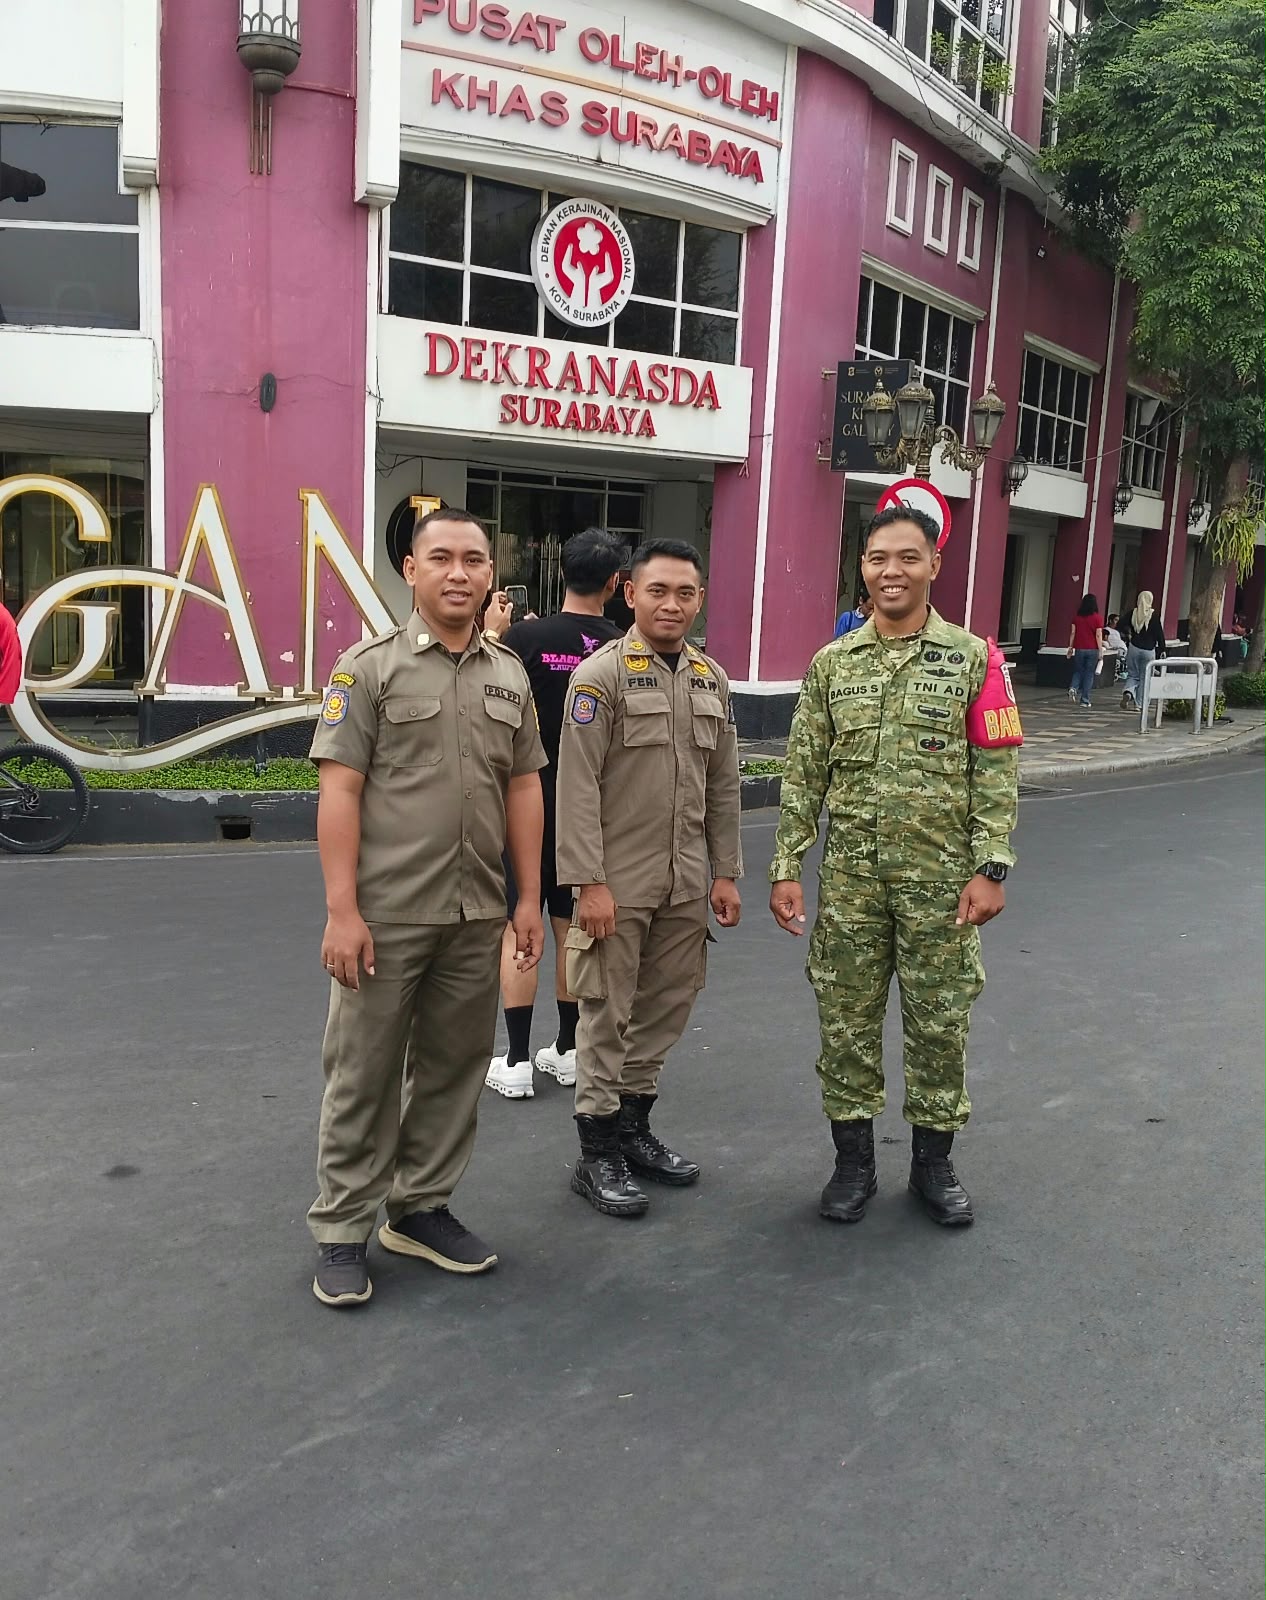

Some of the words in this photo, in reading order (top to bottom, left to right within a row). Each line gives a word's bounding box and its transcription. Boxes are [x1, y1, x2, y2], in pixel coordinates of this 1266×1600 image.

[413, 0, 567, 52] PUSAT
[578, 27, 779, 122] OLEH-OLEH
[431, 68, 570, 127] KHAS
[581, 100, 764, 183] SURABAYA
[541, 219, 558, 262] DEWAN
[556, 203, 610, 223] KERAJINAN
[610, 221, 631, 280] NASIONAL
[549, 286, 570, 314] KOTA
[573, 300, 621, 322] SURABAYA
[424, 332, 722, 410] DEKRANASDA
[499, 393, 657, 437] SURABAYA
[541, 653, 581, 664] BLACK
[488, 687, 505, 698] POL
[507, 692, 518, 702] PP
[628, 677, 657, 687] FERI
[690, 677, 707, 689] POL
[830, 685, 867, 700] BAGUS
[870, 684, 879, 693] S
[913, 682, 938, 693] TNI
[944, 685, 965, 697] AD
[983, 705, 1022, 741] BAB
